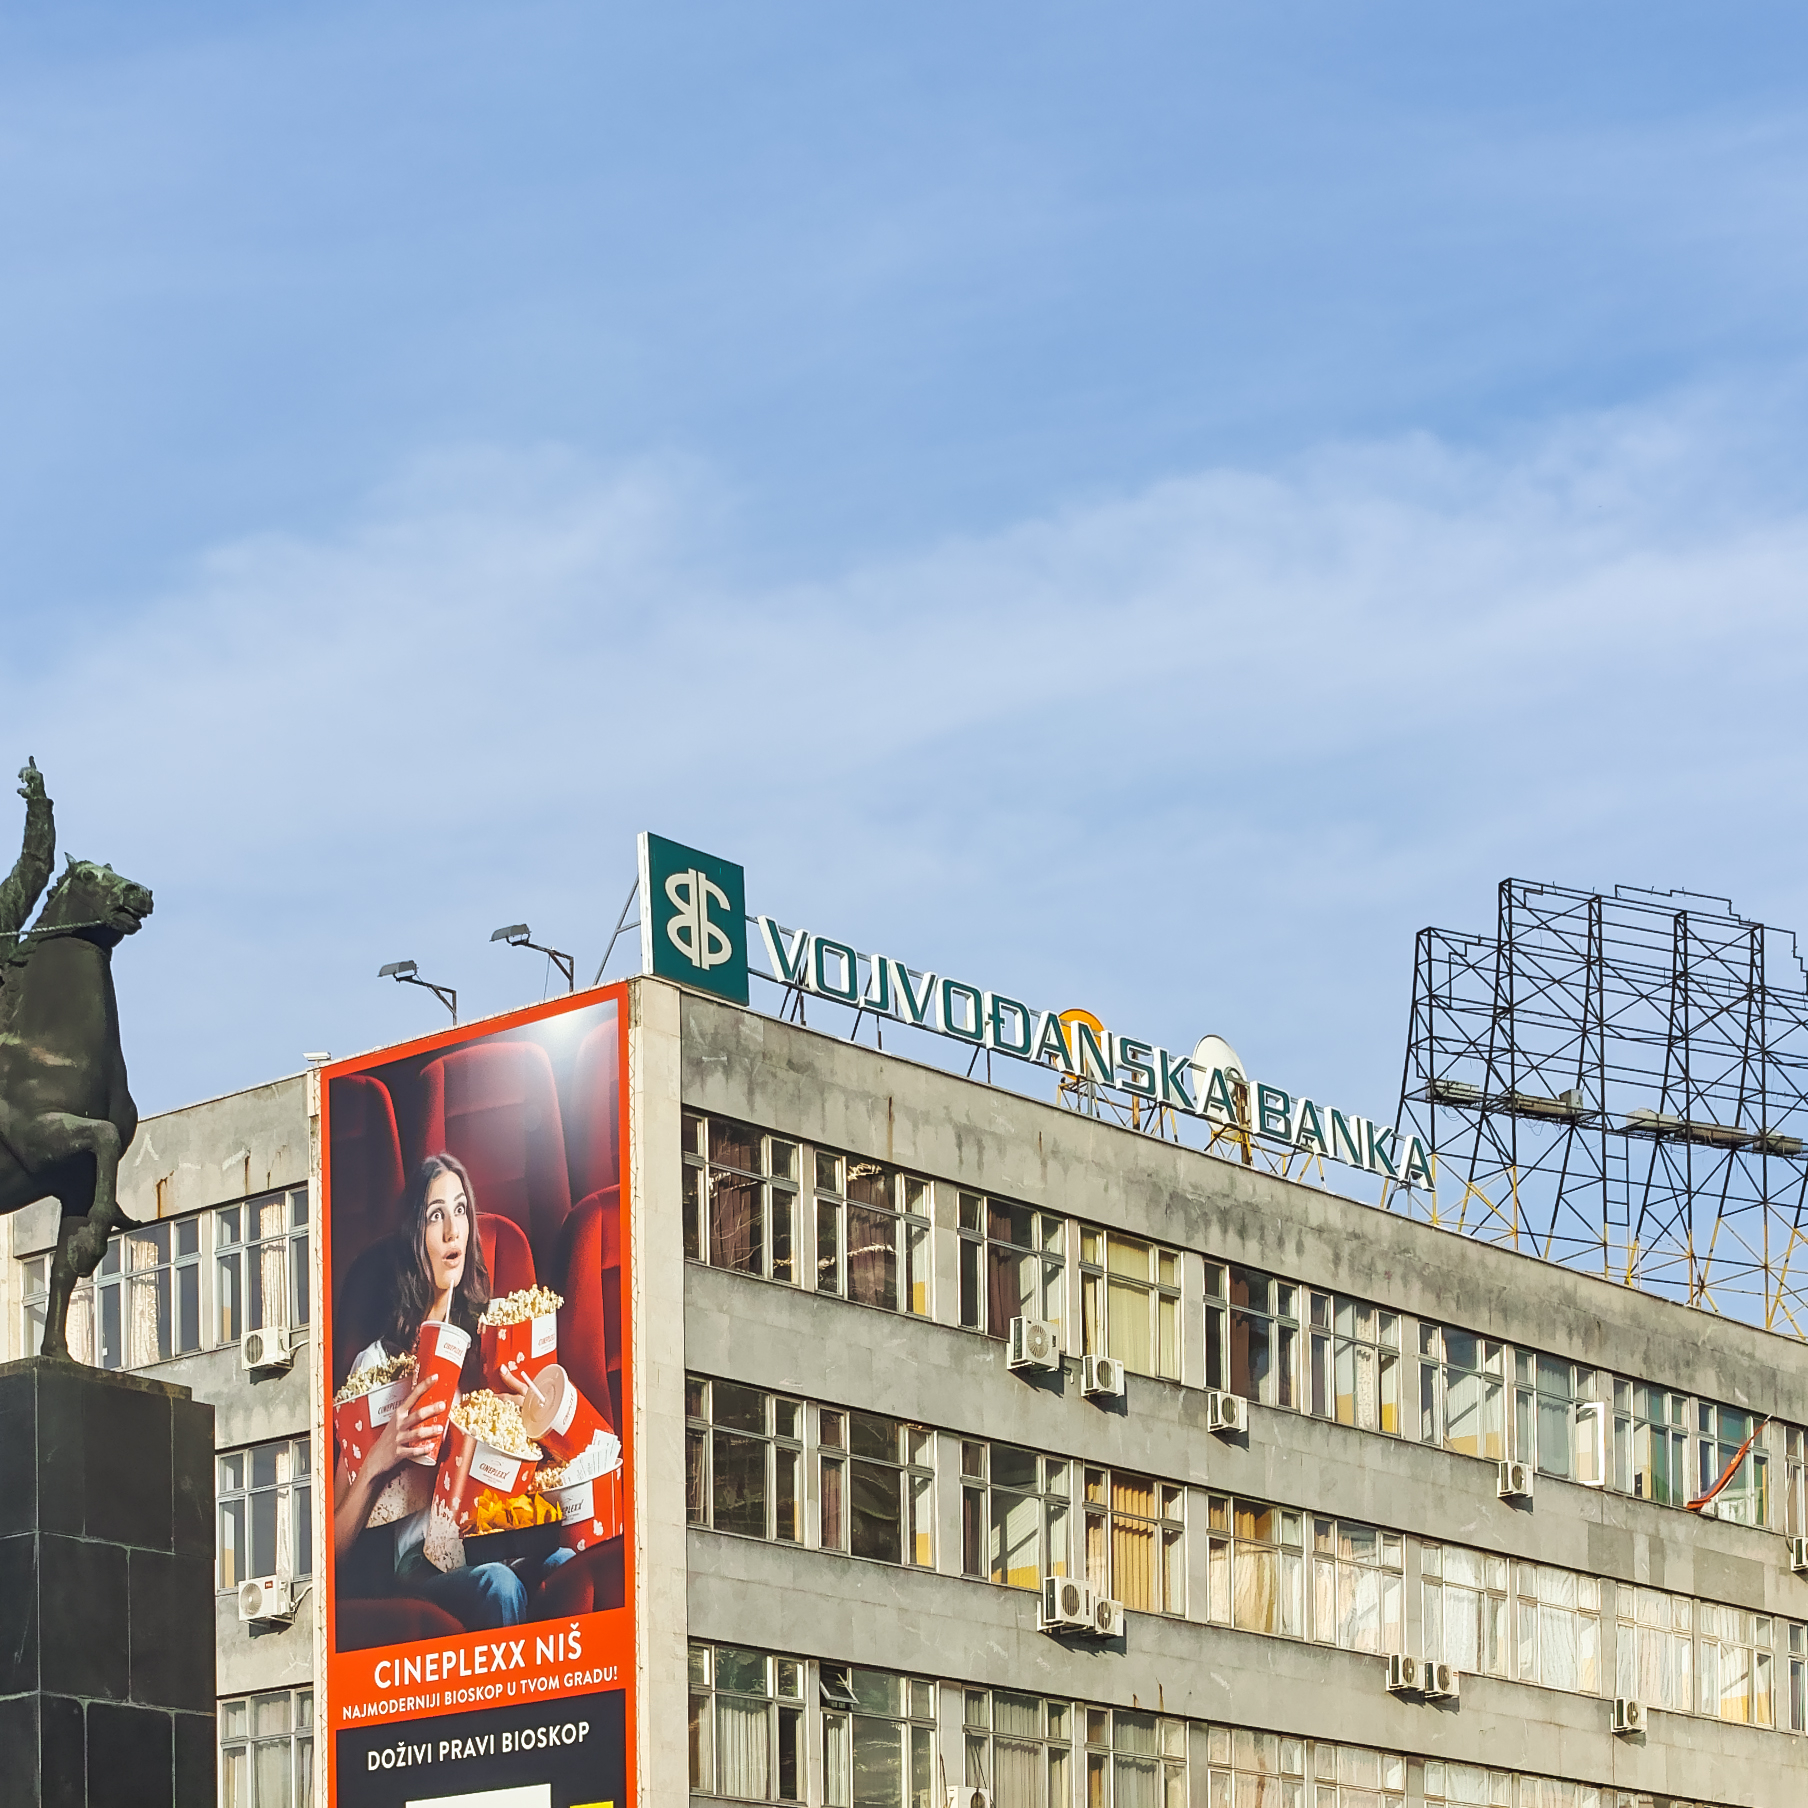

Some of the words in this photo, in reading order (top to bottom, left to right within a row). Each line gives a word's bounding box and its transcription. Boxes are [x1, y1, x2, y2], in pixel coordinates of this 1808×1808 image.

[756, 914, 1235, 1124] VOJVOĐANSKA
[1249, 1080, 1434, 1191] BANKA
[479, 1462, 510, 1480] CINEPLEXX
[374, 1639, 526, 1689] CINEPLEXX
[536, 1622, 582, 1665] NIŠ
[342, 1692, 440, 1721] NAJMODERNIJI
[444, 1683, 503, 1706] BIOSKOP
[507, 1682, 517, 1696] U
[520, 1675, 560, 1694] TVOM
[564, 1665, 618, 1687] GRADU!
[367, 1741, 432, 1771] DOŽIVI
[439, 1734, 495, 1762] PRAVI
[502, 1721, 590, 1753] BIOSKOP
